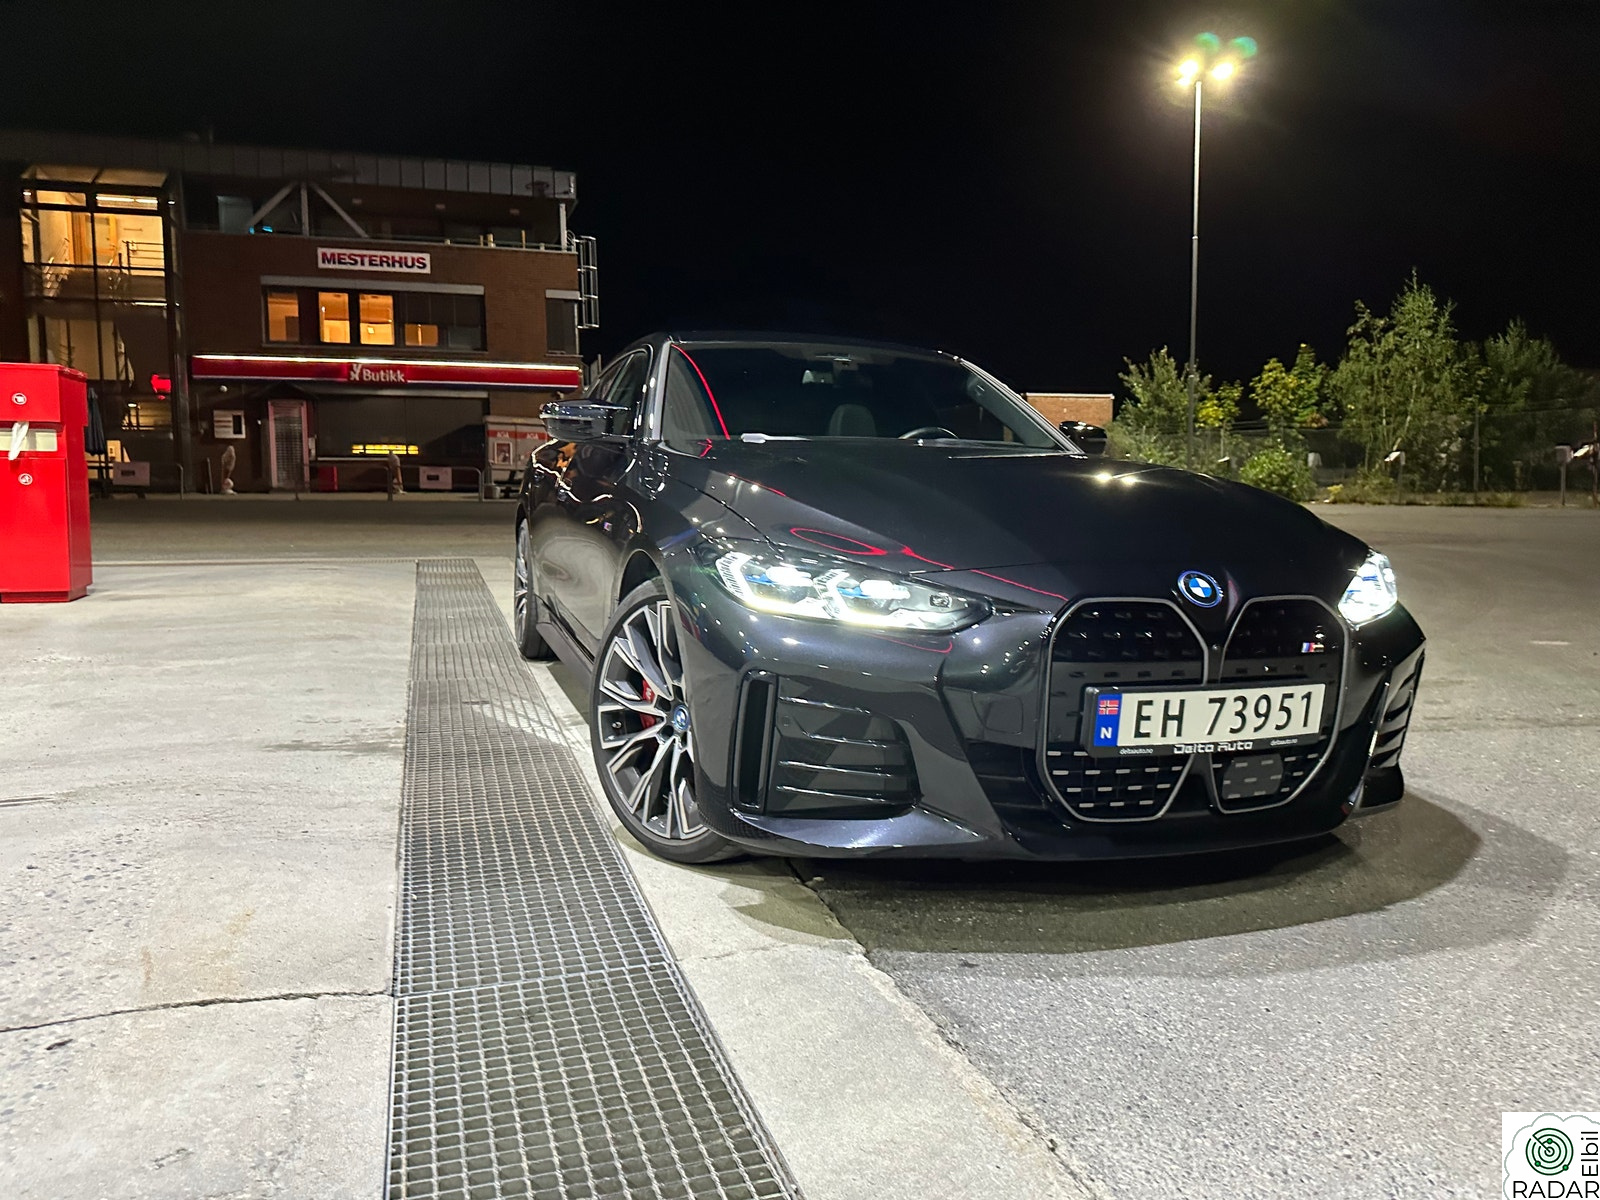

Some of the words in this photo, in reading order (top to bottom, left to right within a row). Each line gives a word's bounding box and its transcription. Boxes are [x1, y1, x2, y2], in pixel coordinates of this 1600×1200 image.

[321, 251, 427, 270] MESTERHUS
[363, 368, 405, 383] Butikk
[1133, 699, 1185, 739] EH
[1206, 691, 1312, 736] 73951
[1100, 727, 1113, 739] N
[1173, 743, 1214, 754] Delta
[1217, 741, 1253, 752] Auto
